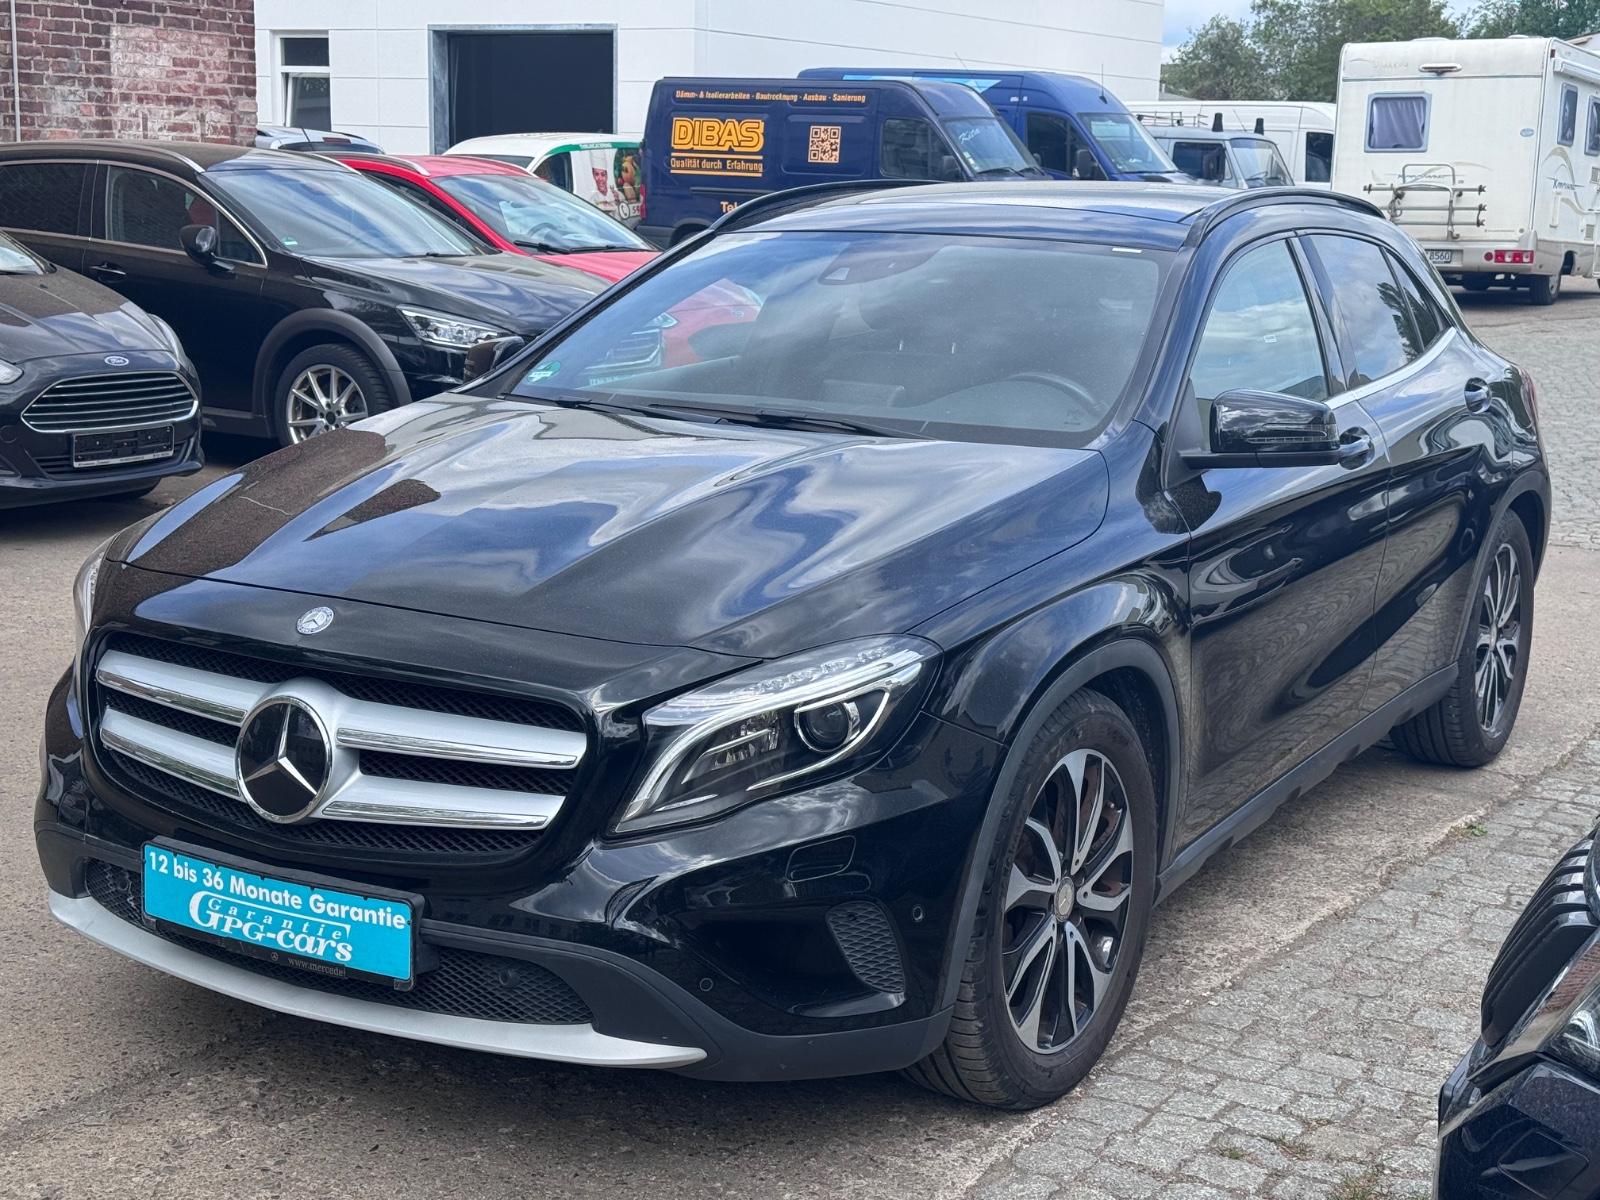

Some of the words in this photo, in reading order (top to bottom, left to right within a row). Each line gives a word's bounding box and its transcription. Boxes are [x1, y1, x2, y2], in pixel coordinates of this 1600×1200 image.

[699, 91, 704, 99] &
[705, 91, 750, 100] Isolierarbeiten
[755, 92, 798, 102] Bautrocknung
[803, 93, 827, 102] Ausbau
[832, 93, 866, 103] Sanierung
[671, 117, 764, 152] DIBAS
[670, 158, 700, 169] Qualität
[701, 159, 722, 170] durch
[726, 160, 763, 173] Erfahrung
[149, 851, 168, 874] 12
[173, 858, 198, 883] bis
[202, 867, 224, 890] 36
[229, 875, 303, 910] Monate
[309, 893, 406, 929] Garantie
[189, 890, 353, 961] GPG-cars
[208, 898, 342, 940] Garantie
